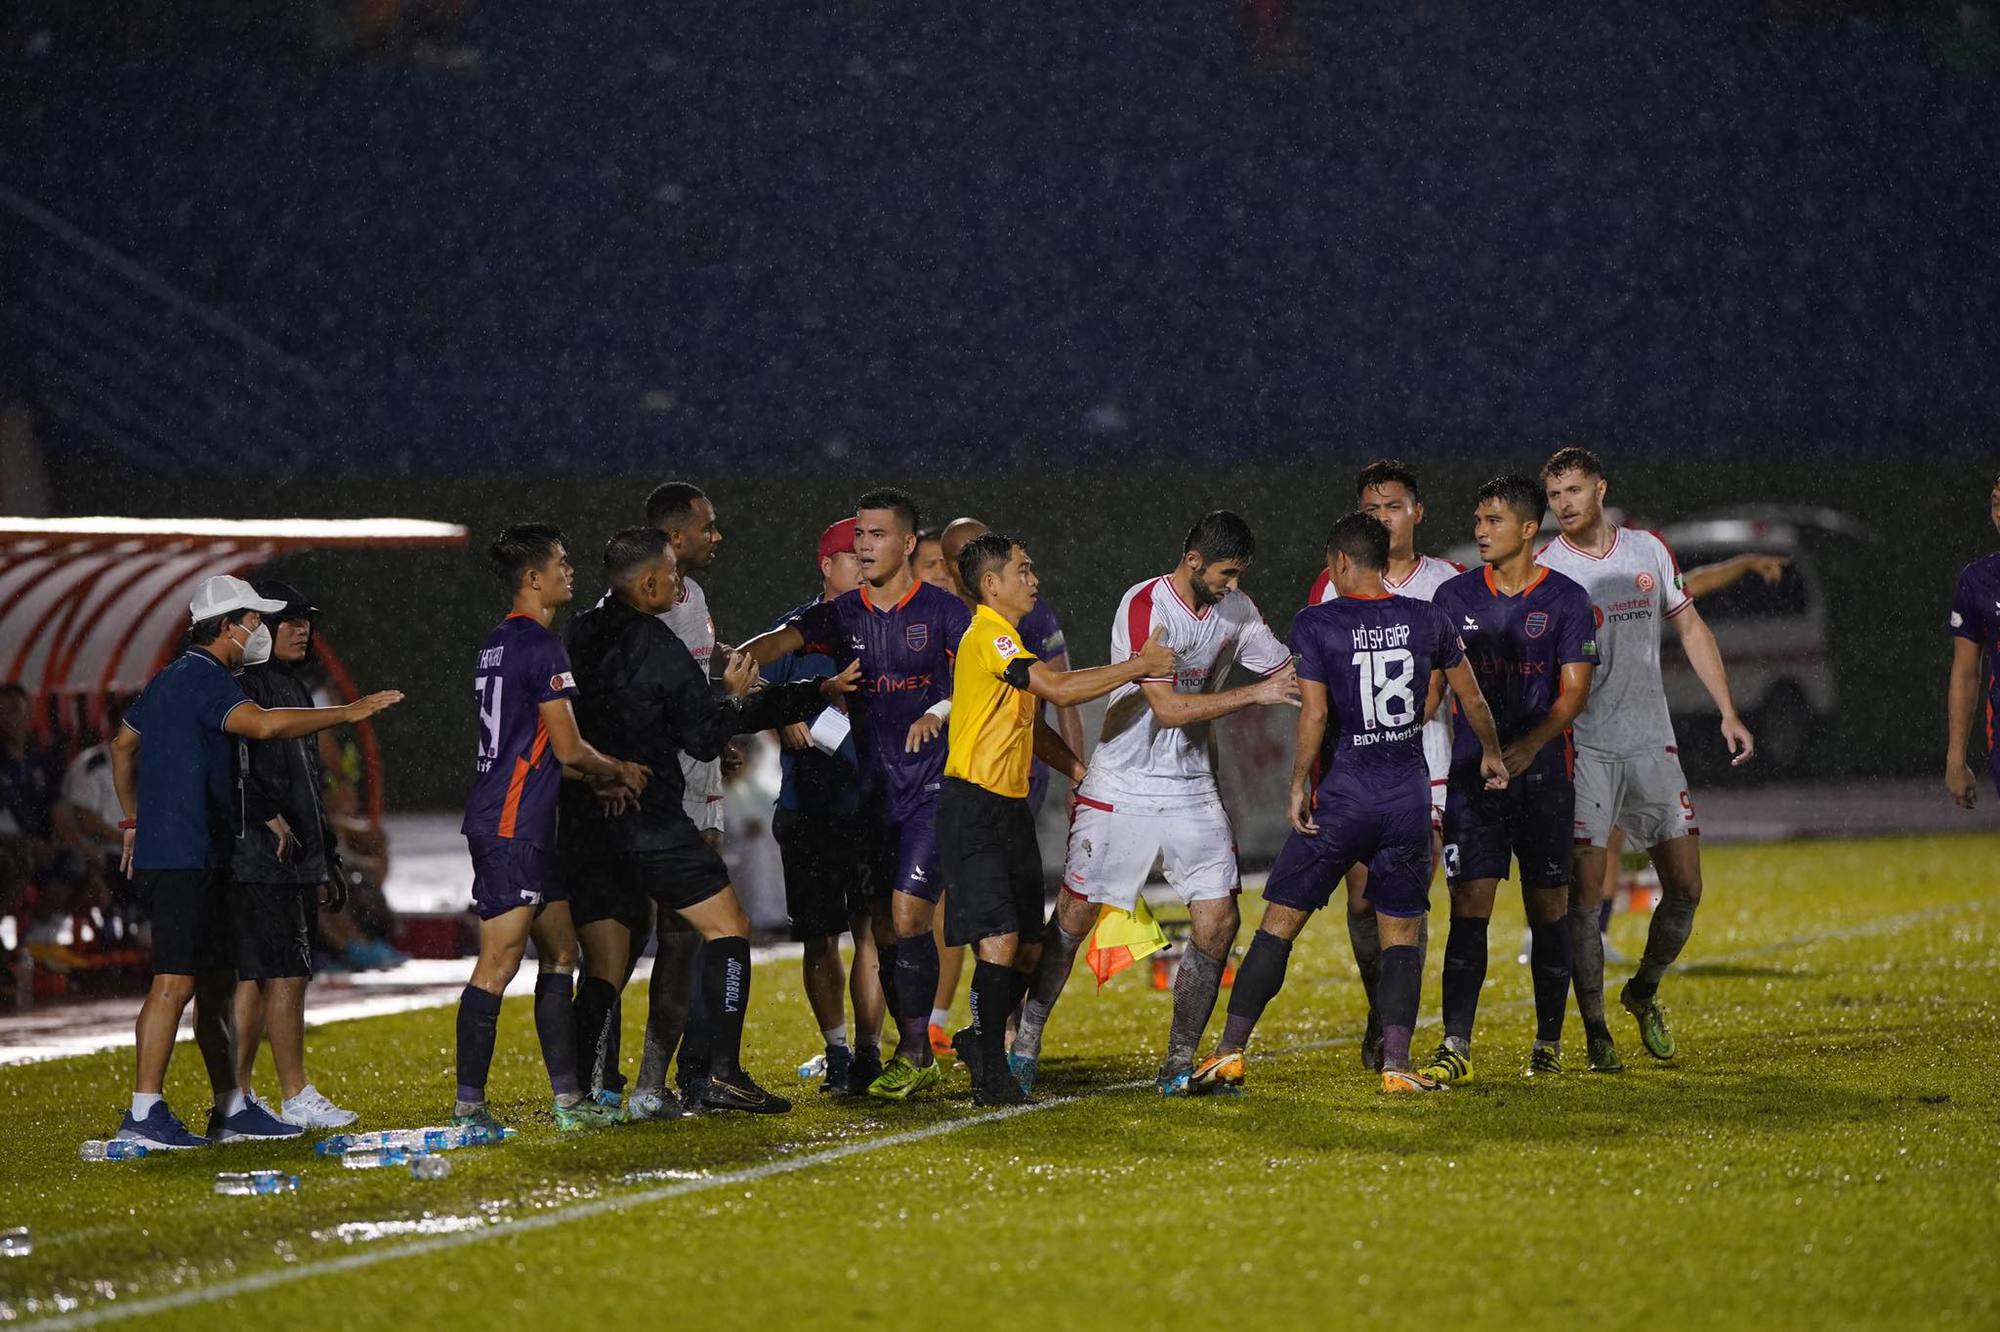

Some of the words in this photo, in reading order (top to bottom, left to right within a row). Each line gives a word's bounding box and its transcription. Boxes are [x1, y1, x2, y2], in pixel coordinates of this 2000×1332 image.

[1608, 598, 1650, 612] viettel
[1608, 610, 1653, 623] money
[1352, 623, 1368, 649] HỒ
[1369, 626, 1383, 649] SỸ
[1385, 623, 1410, 648] GIÁP
[1352, 648, 1416, 730] 18
[1680, 790, 1696, 820] 9
[725, 957, 742, 1013] JOGARBOLA
